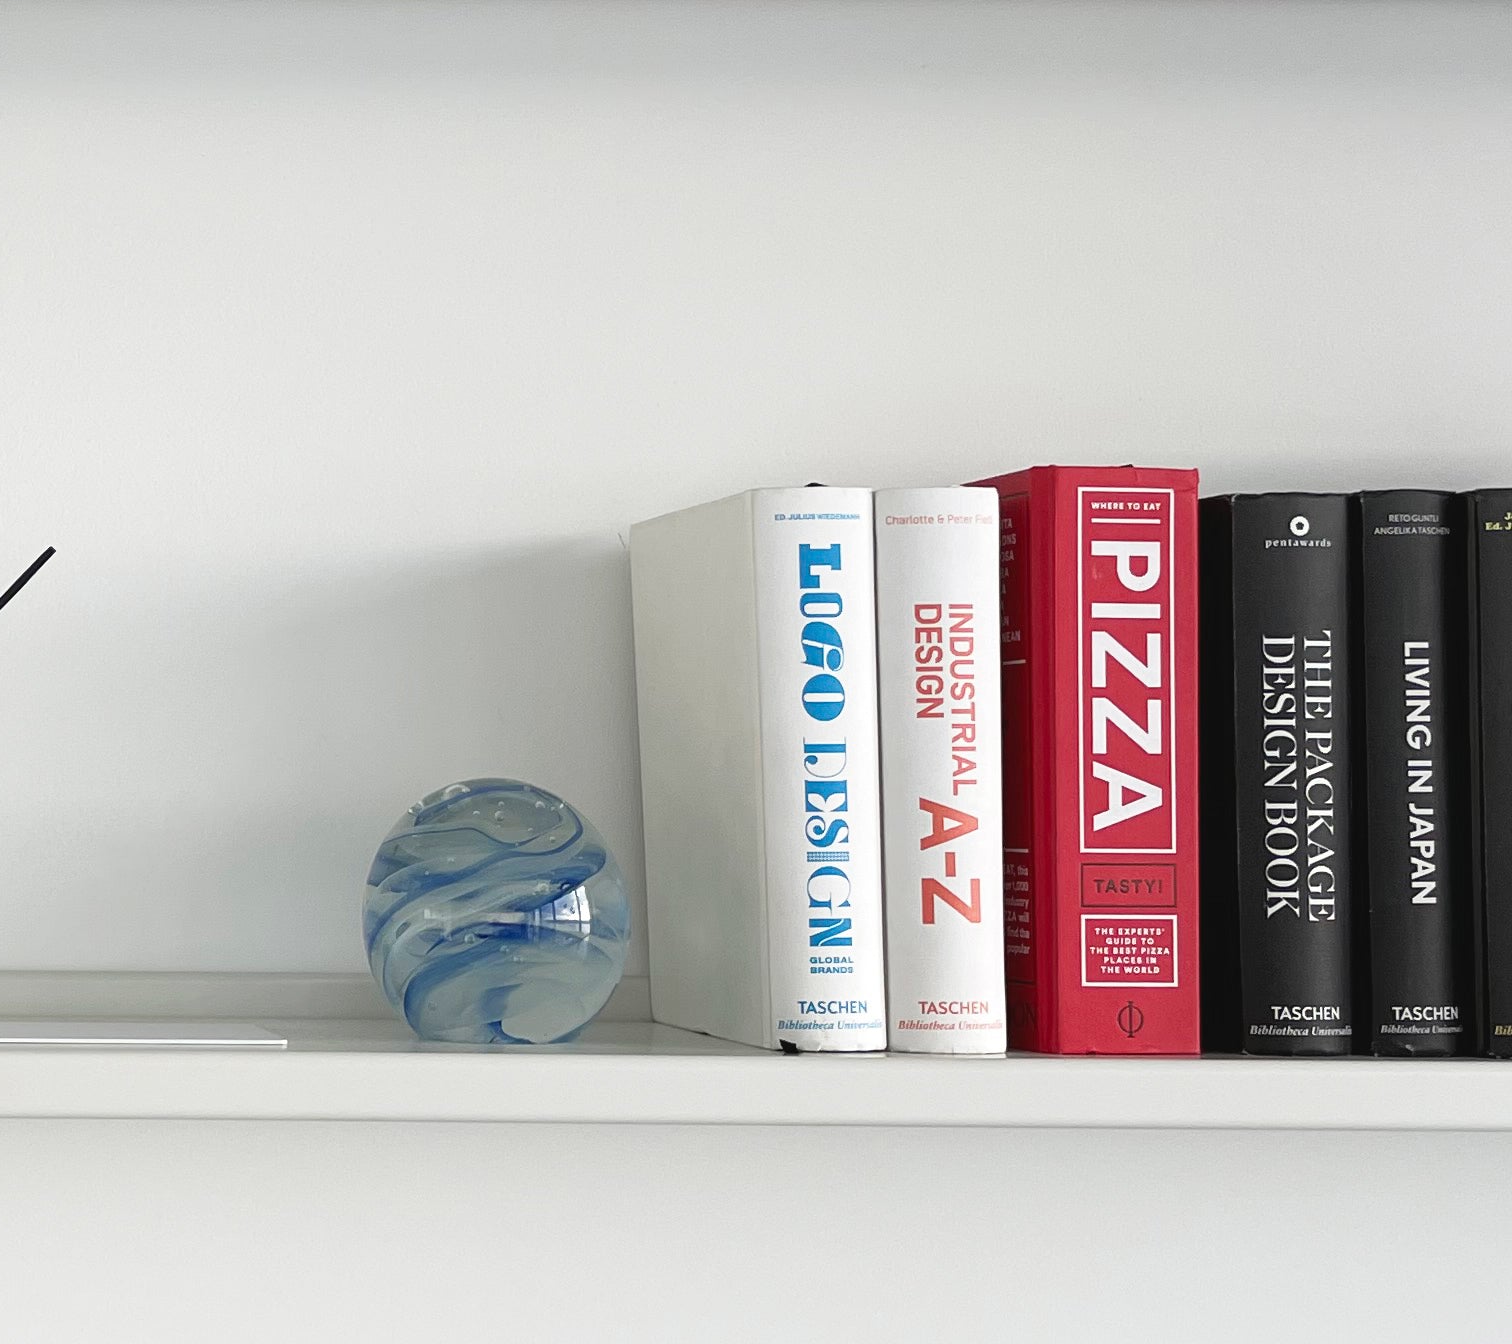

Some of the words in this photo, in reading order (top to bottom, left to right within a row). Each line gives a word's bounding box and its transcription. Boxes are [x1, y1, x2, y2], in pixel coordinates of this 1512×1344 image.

[1127, 503, 1140, 511] TO
[1264, 539, 1331, 549] pentawards
[799, 544, 845, 721] LOGO
[915, 604, 944, 718] DESIGN
[1304, 630, 1332, 718] THE
[949, 604, 977, 796] INDUSTRIAL
[1092, 541, 1162, 831] PIZZA
[1263, 636, 1297, 789] DESIGN
[1405, 642, 1431, 749] LIVING
[1306, 730, 1335, 921] PACKAGE
[1408, 760, 1433, 792] IN
[803, 738, 852, 947] DESIGN
[919, 797, 980, 924] A-Z
[1093, 879, 1162, 893] TASTY!
[1265, 800, 1300, 917] BOOK
[1409, 803, 1436, 903] JAPAN
[1106, 938, 1136, 946] GUIDE
[797, 1001, 866, 1014] TASCHEN
[918, 1001, 988, 1014] TASCHEN
[1272, 1007, 1340, 1020] TASCHEN
[1392, 1007, 1458, 1020] TASCHEN
